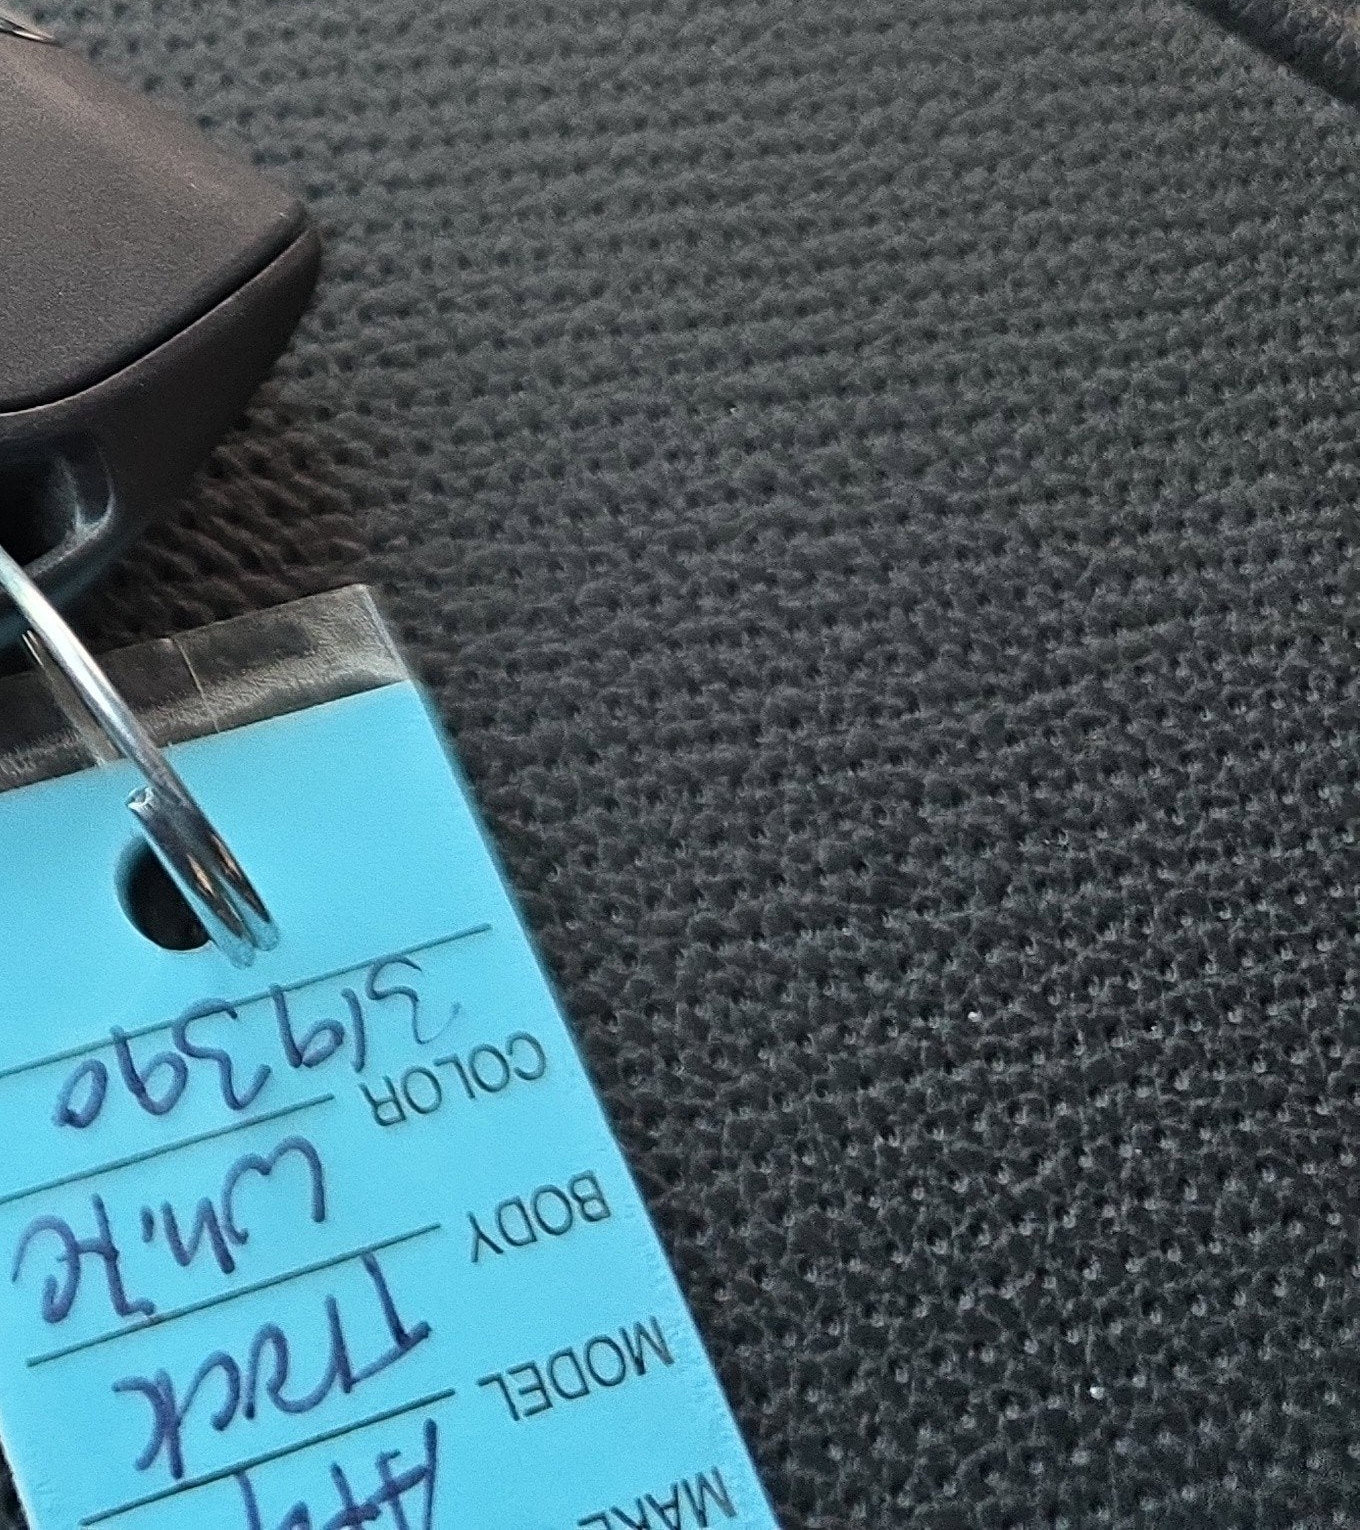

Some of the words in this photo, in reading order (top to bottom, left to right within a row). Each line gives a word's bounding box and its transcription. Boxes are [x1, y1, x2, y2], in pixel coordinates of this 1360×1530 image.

[53, 955, 462, 1128] 319390
[358, 1031, 547, 1127] COLOR
[467, 1170, 611, 1263] BODY
[477, 1316, 675, 1421] MODEL
